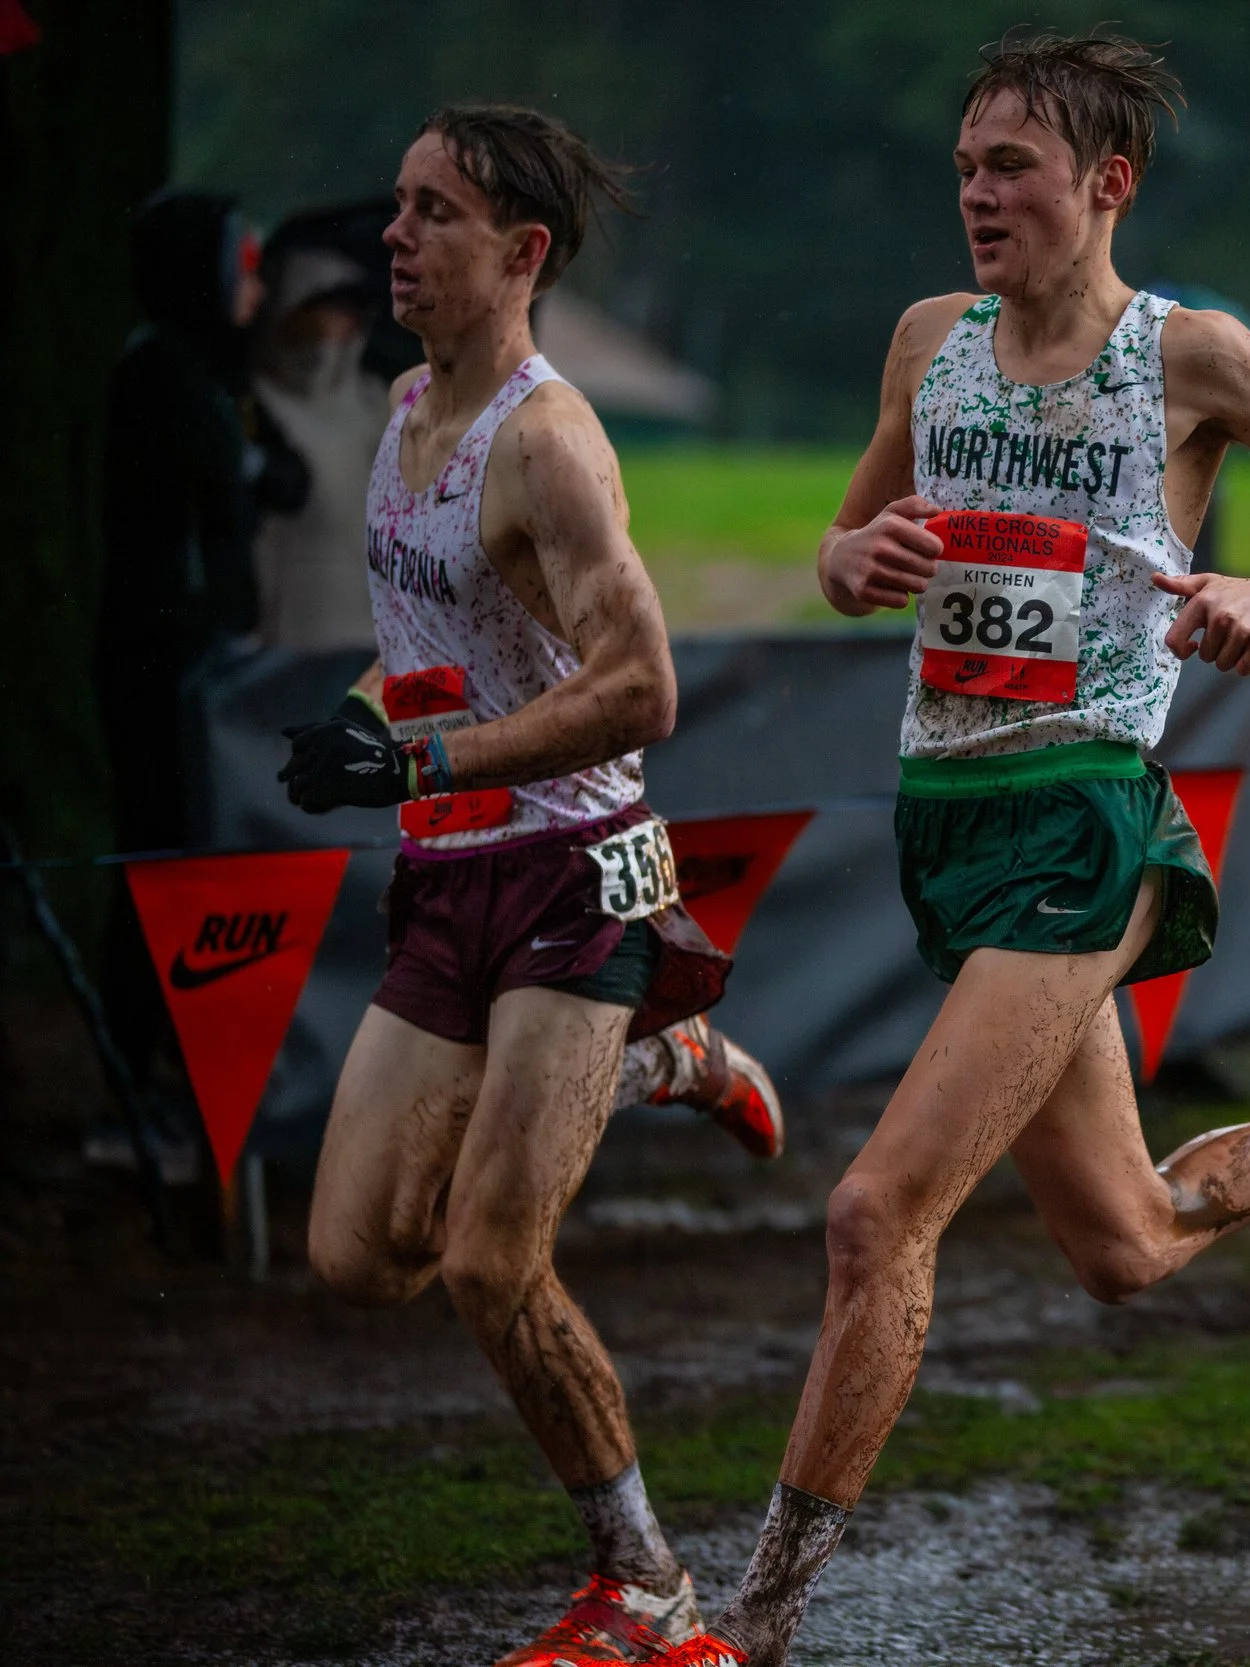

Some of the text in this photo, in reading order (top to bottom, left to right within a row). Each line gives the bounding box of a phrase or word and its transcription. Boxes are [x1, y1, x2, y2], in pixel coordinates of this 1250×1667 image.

[928, 425, 1129, 497] NORTHWEST
[947, 515, 1060, 539] NIKE CROSS
[950, 533, 1054, 556] NATIONALS
[964, 569, 1035, 588] KITCHEN
[939, 591, 1054, 654] 382
[963, 659, 988, 673] RUN
[194, 911, 289, 955] RUN
